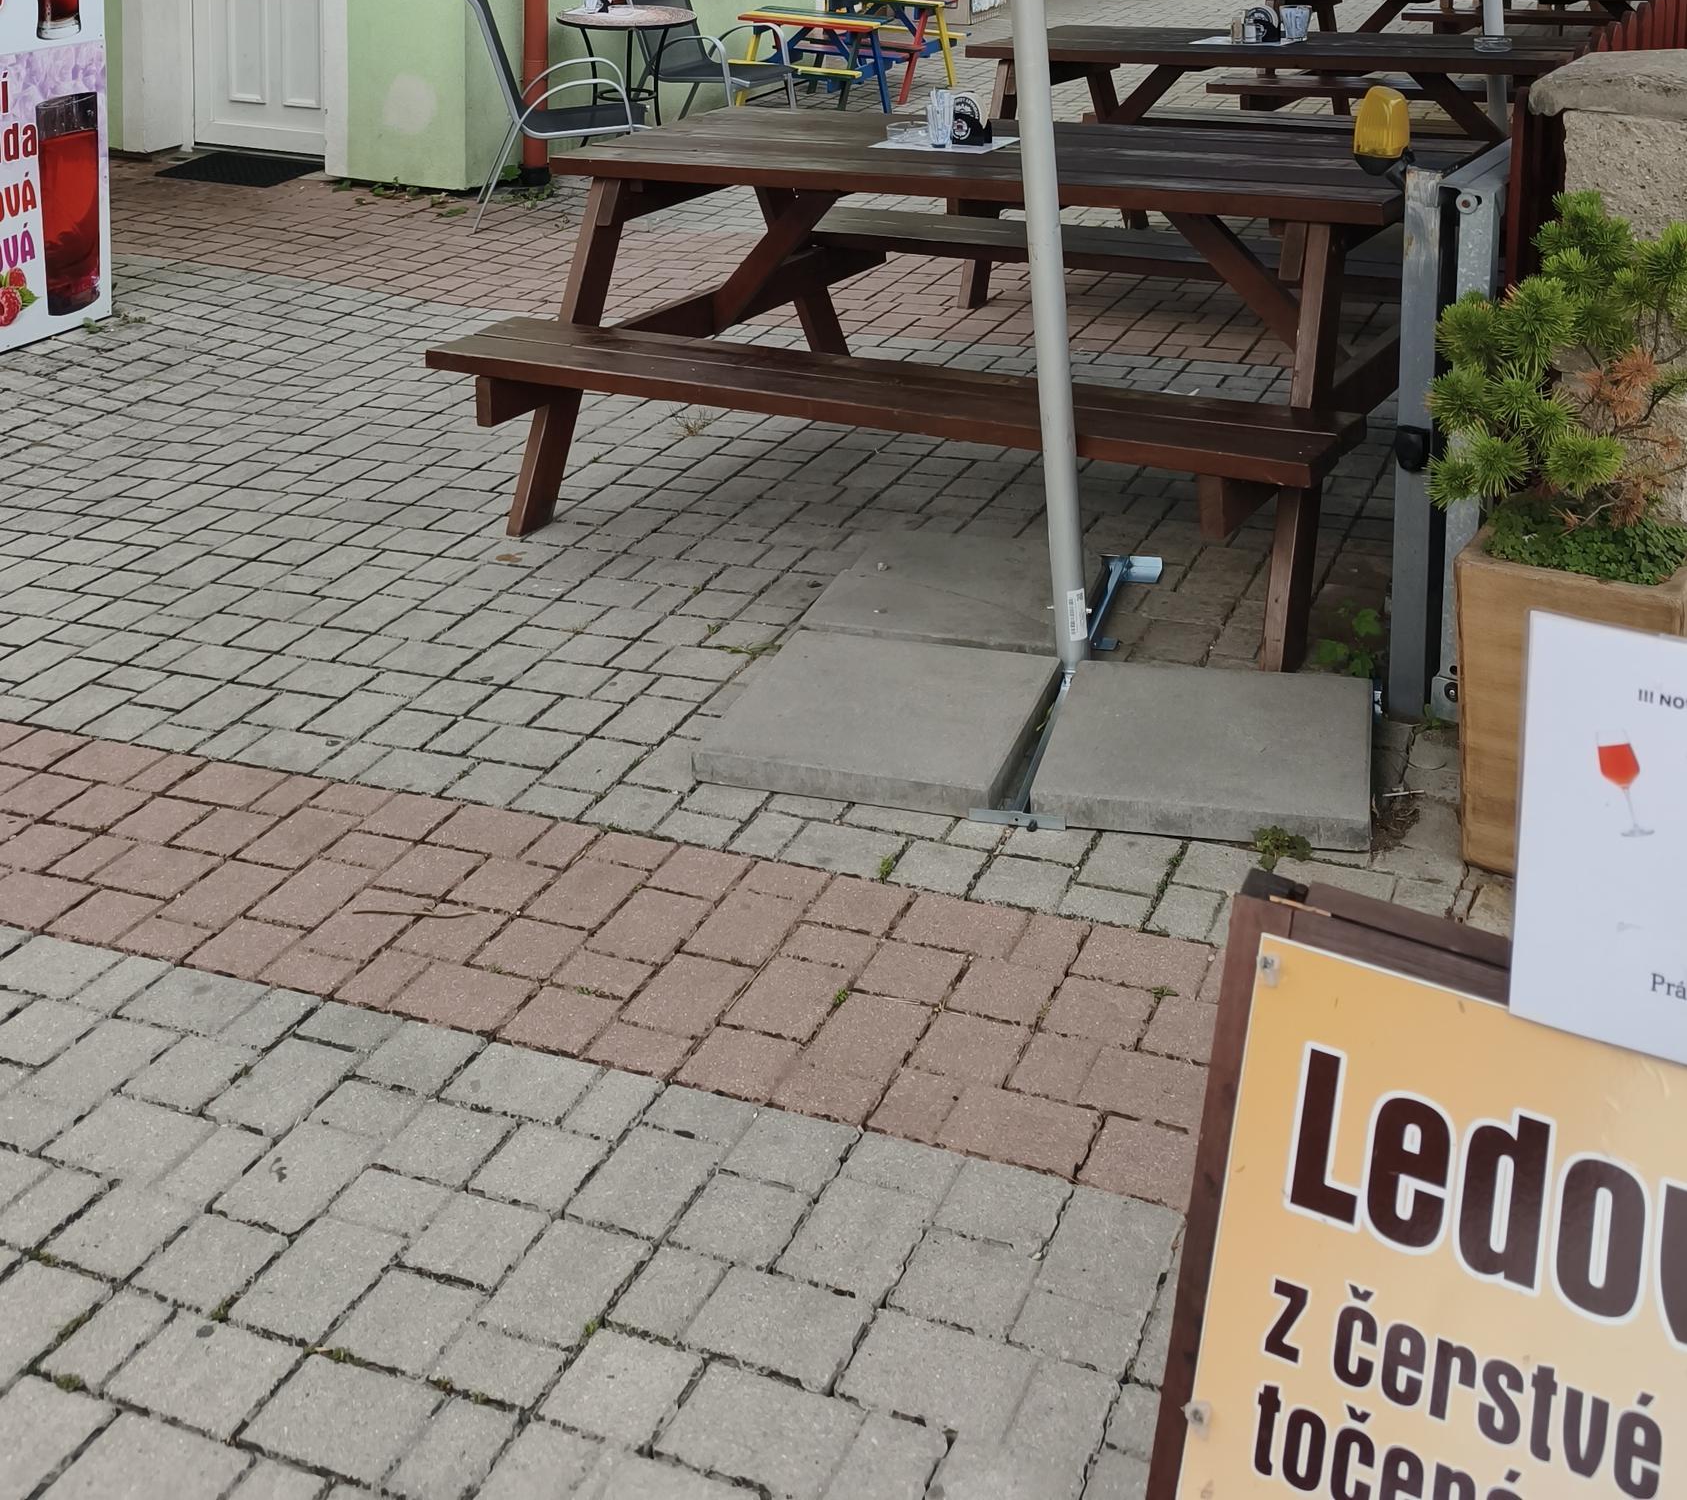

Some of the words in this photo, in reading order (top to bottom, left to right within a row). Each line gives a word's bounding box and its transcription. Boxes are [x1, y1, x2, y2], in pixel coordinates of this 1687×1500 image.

[1659, 693, 1687, 710] NO
[1264, 1278, 1309, 1365] z
[1333, 1283, 1663, 1500] čerstvé
